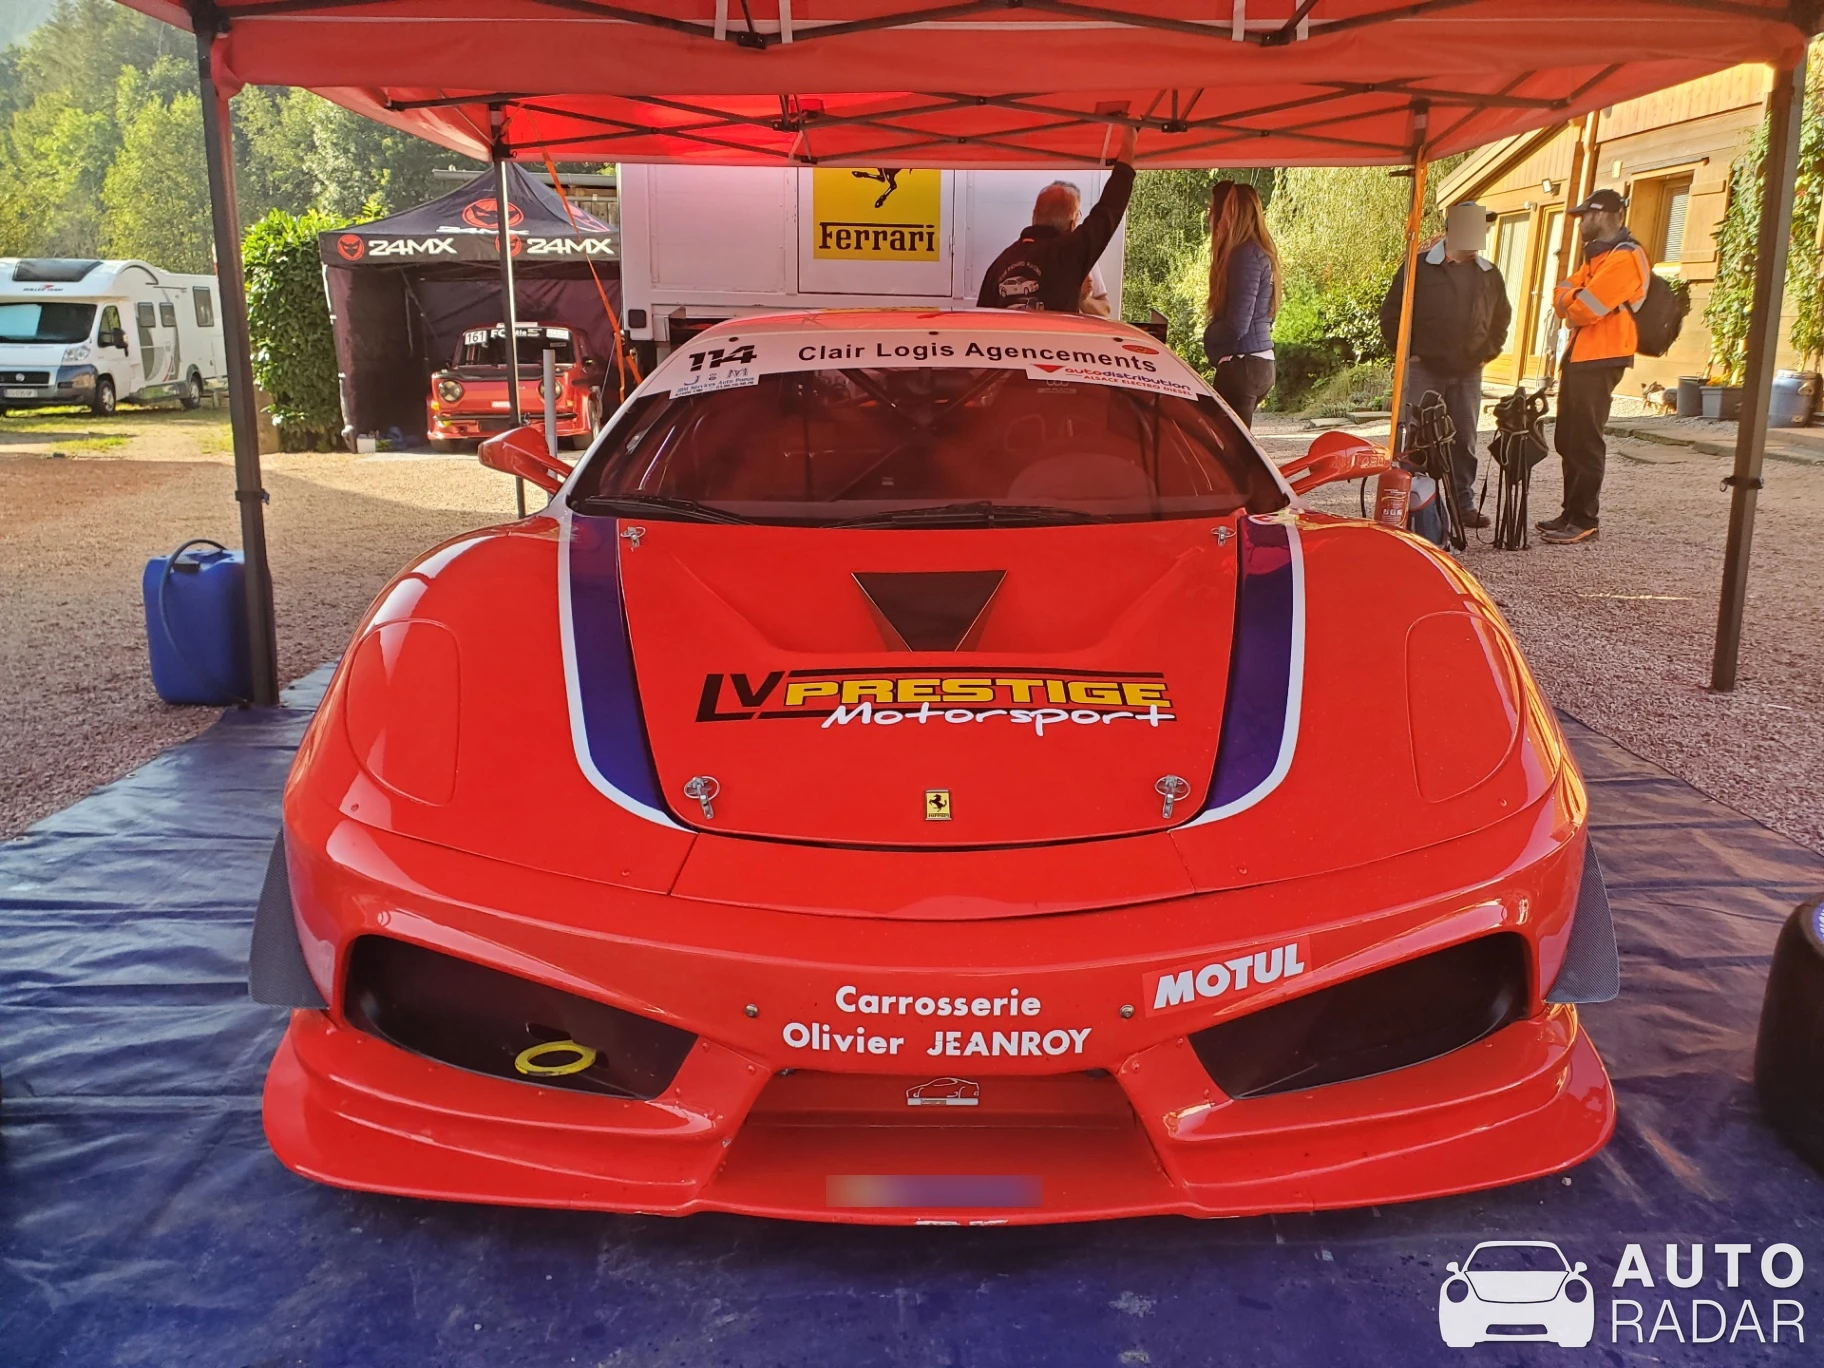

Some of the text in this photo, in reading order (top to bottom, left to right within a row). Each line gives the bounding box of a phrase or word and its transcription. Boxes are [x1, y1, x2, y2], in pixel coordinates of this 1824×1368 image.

[368, 237, 458, 257] 24MX
[527, 237, 614, 255] 24MX
[818, 222, 935, 252] Ferrari
[467, 331, 486, 344] 161
[688, 344, 757, 372] 114
[798, 342, 1157, 373] Clair Logis Agencements
[1065, 368, 1192, 391] autodistribution
[1084, 375, 1193, 396] ALSACE ELECTRO DIESEL
[784, 678, 1173, 708] PRESTIGE
[821, 701, 1176, 737] Motorsport
[1153, 943, 1304, 1010] MOTUL
[835, 985, 1042, 1017] Carrosserie
[782, 1022, 1092, 1057] Olivier JEANROY
